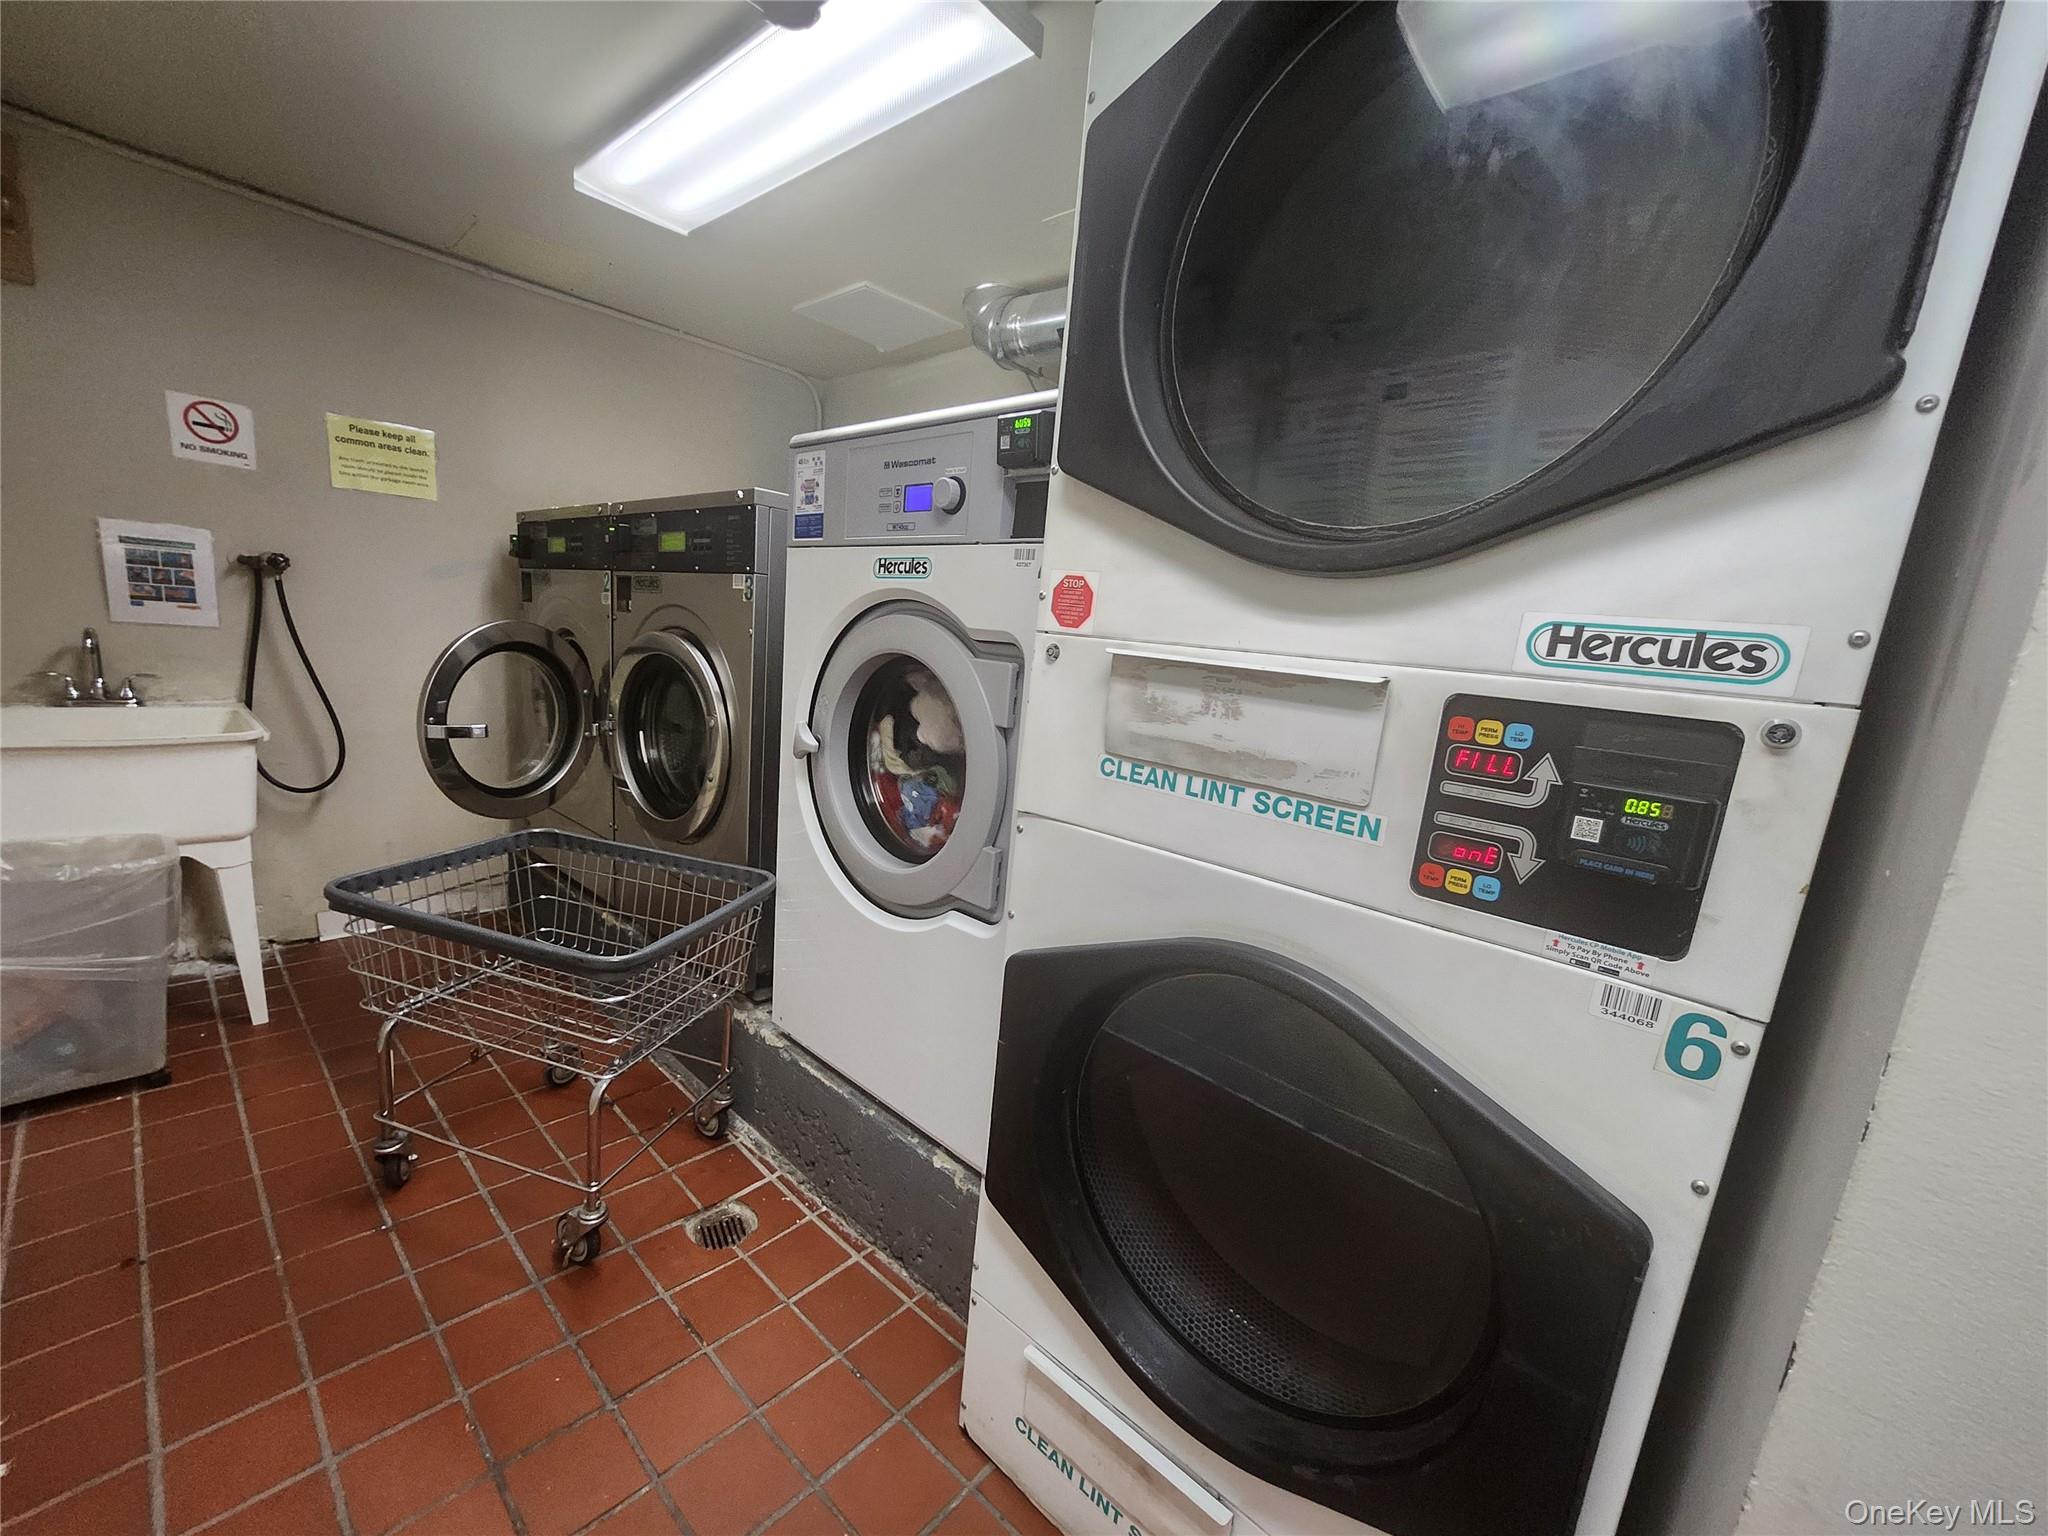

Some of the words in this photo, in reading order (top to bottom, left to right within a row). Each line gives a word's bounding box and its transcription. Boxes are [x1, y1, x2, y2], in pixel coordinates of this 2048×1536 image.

[349, 424, 380, 437] Please
[382, 430, 403, 442] keep
[405, 435, 416, 443] all
[180, 442, 197, 451] NO
[199, 446, 249, 460] SMOKING
[335, 435, 376, 448] common
[378, 442, 402, 453] areas
[891, 457, 937, 469] Wascomat
[877, 557, 928, 575] Hercules
[1063, 578, 1085, 588] STOP
[1545, 623, 1769, 675] Hercules
[1478, 732, 1500, 740] PRESS
[1480, 726, 1498, 734] PERM
[1509, 735, 1528, 743] TEMP
[1455, 749, 1516, 777] FILL
[1099, 756, 1177, 792] CLEAN
[1185, 774, 1245, 808] LINT
[1252, 790, 1382, 842] SCREEN
[1623, 816, 1667, 831] Hercules
[1603, 862, 1624, 873] CARD
[1447, 880, 1468, 890] PRESS
[1449, 875, 1467, 884] PERM
[1477, 887, 1496, 896] TEMP
[1558, 934, 1589, 947] Hercules
[1589, 940, 1600, 949] CP
[1600, 944, 1626, 956] Mobile
[1626, 952, 1644, 962] App
[1566, 942, 1576, 950] To
[1576, 945, 1590, 955] Pay
[1591, 949, 1602, 958] By
[1603, 953, 1629, 965] Phone
[1545, 944, 1570, 957] Simply
[1571, 950, 1589, 961] Scan
[1590, 956, 1602, 966] QR
[1603, 960, 1623, 971] Code
[1624, 966, 1650, 979] Above
[1600, 1007, 1655, 1029] 344068
[1664, 1012, 1728, 1081] 6
[1014, 1416, 1074, 1481] CLEAN
[1078, 1476, 1124, 1526] LINT
